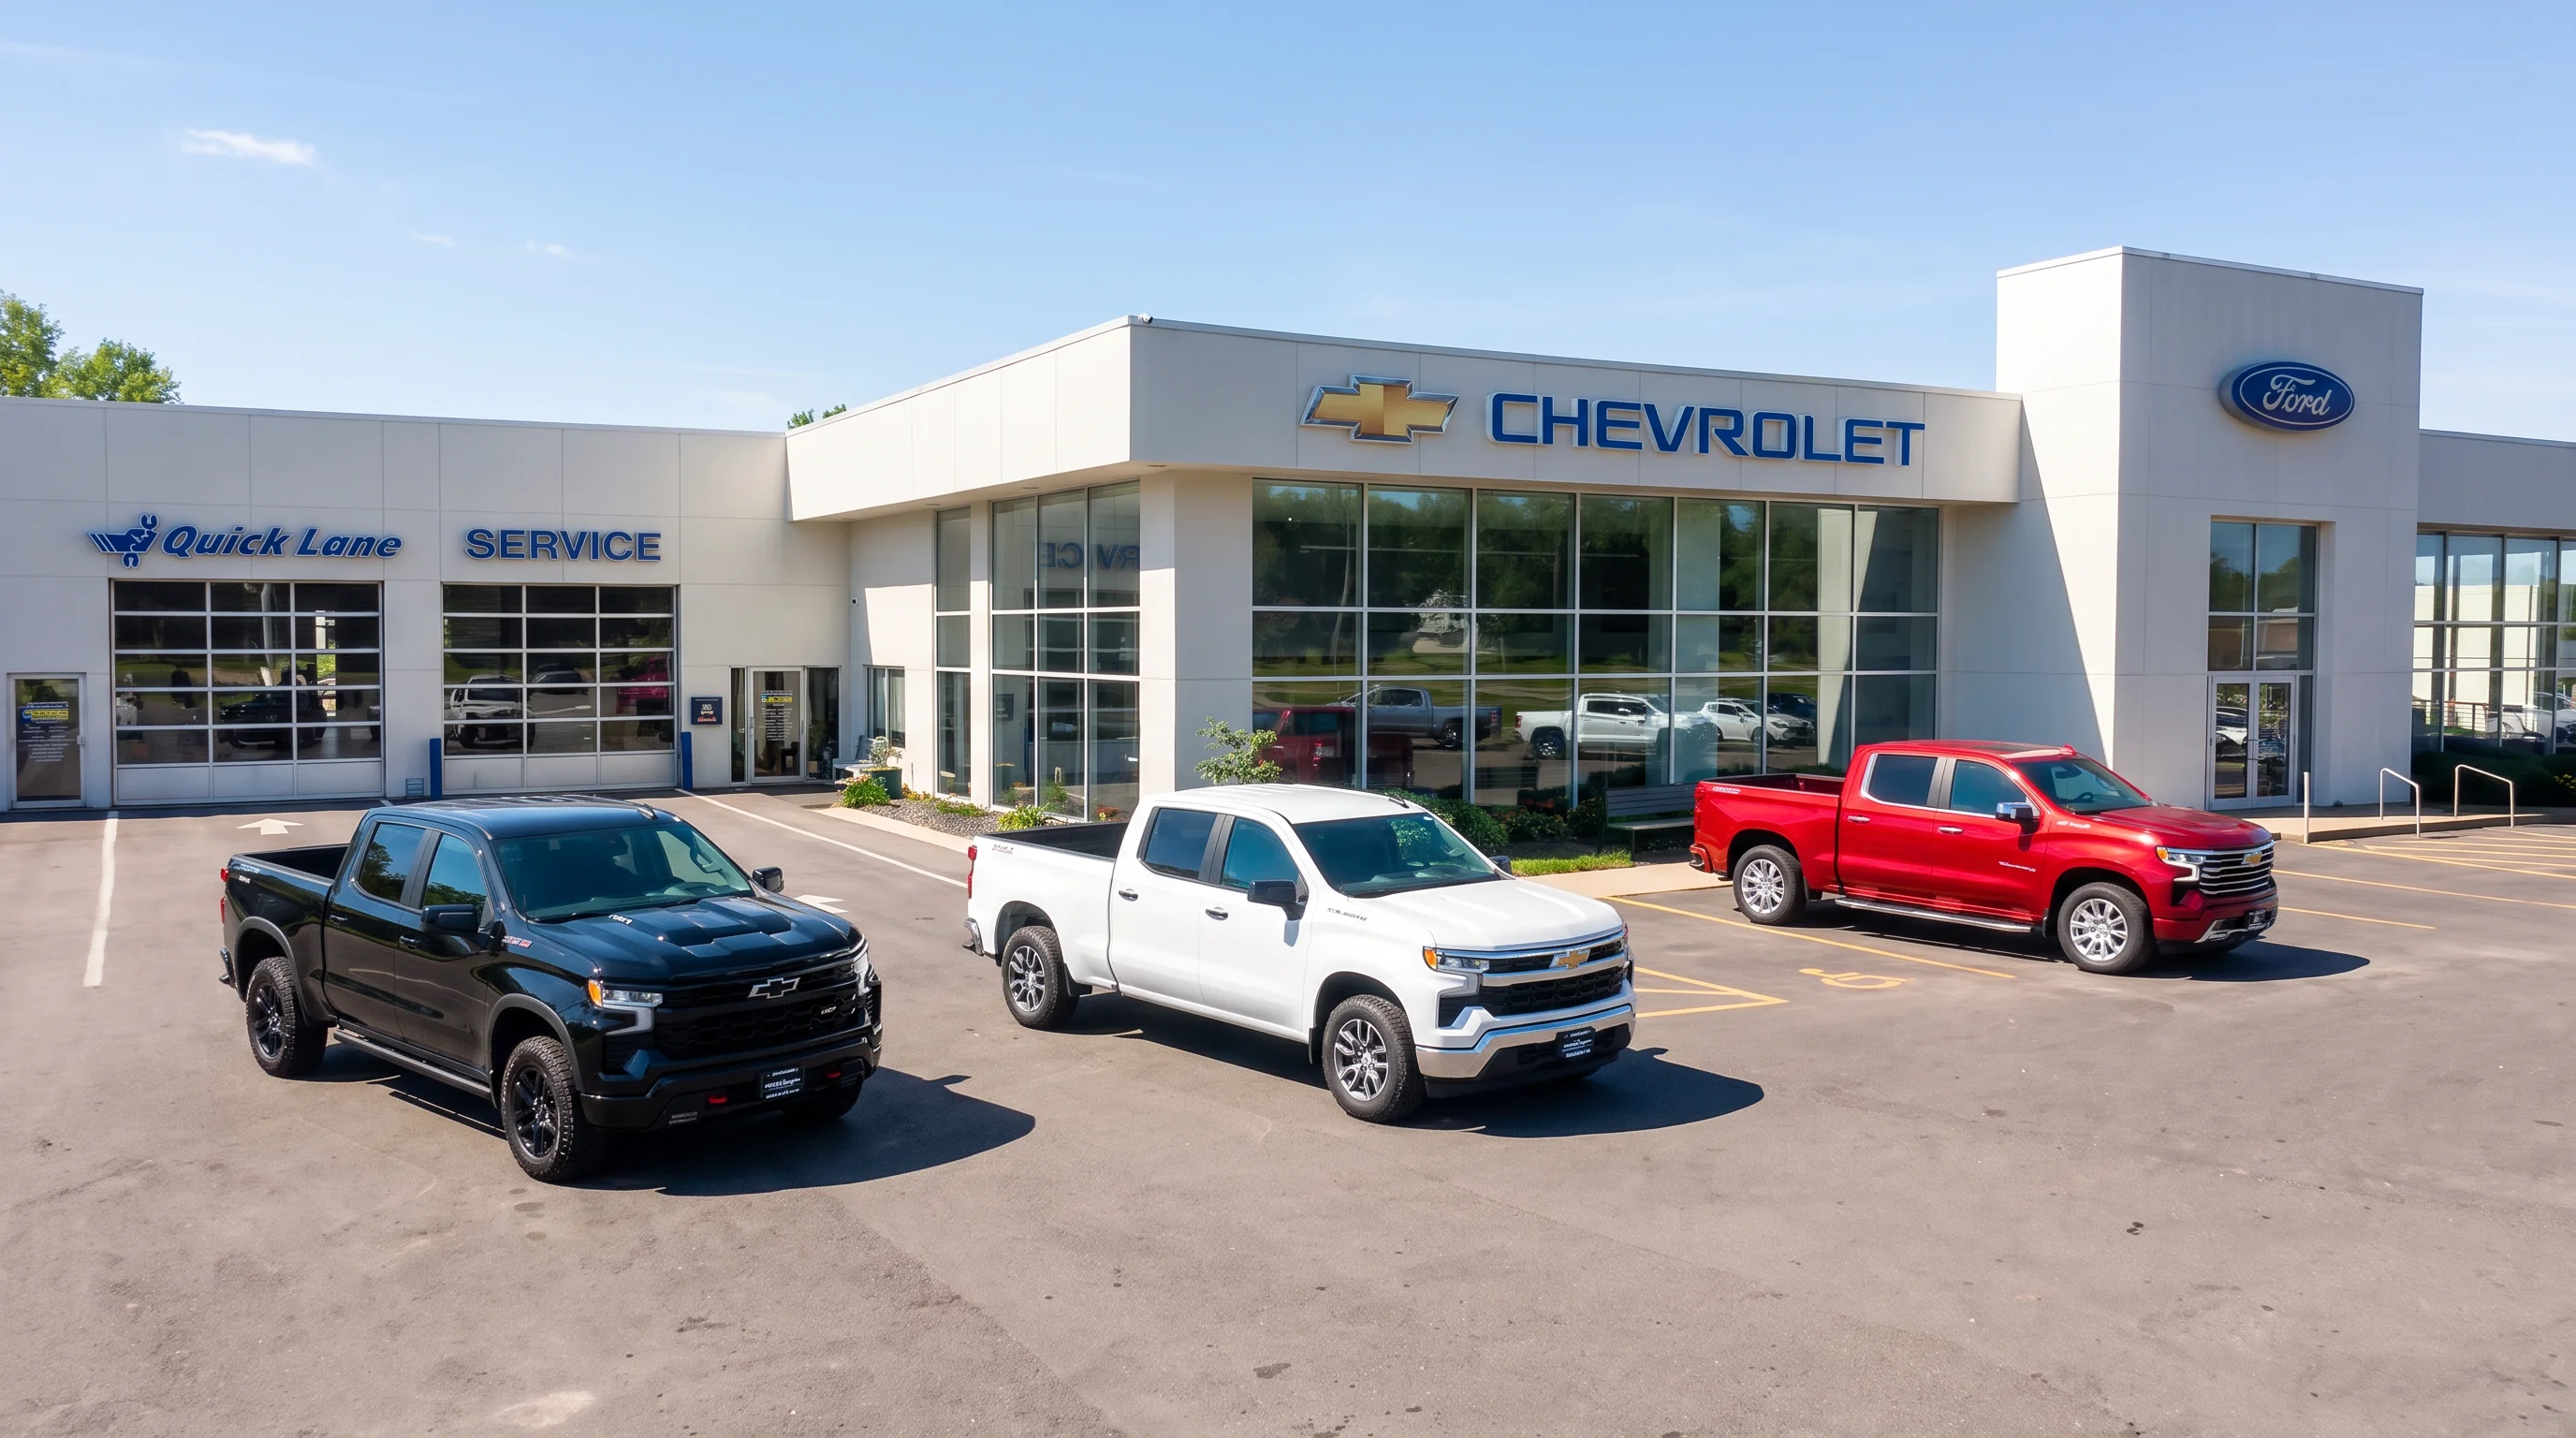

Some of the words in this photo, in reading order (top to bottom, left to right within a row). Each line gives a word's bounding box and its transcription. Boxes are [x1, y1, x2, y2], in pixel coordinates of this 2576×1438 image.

[2263, 374, 2333, 416] Ford
[1486, 391, 1926, 467] CHEVROLET
[162, 525, 293, 558] Quick
[294, 527, 402, 558] Lane
[465, 528, 662, 562] SERVICE
